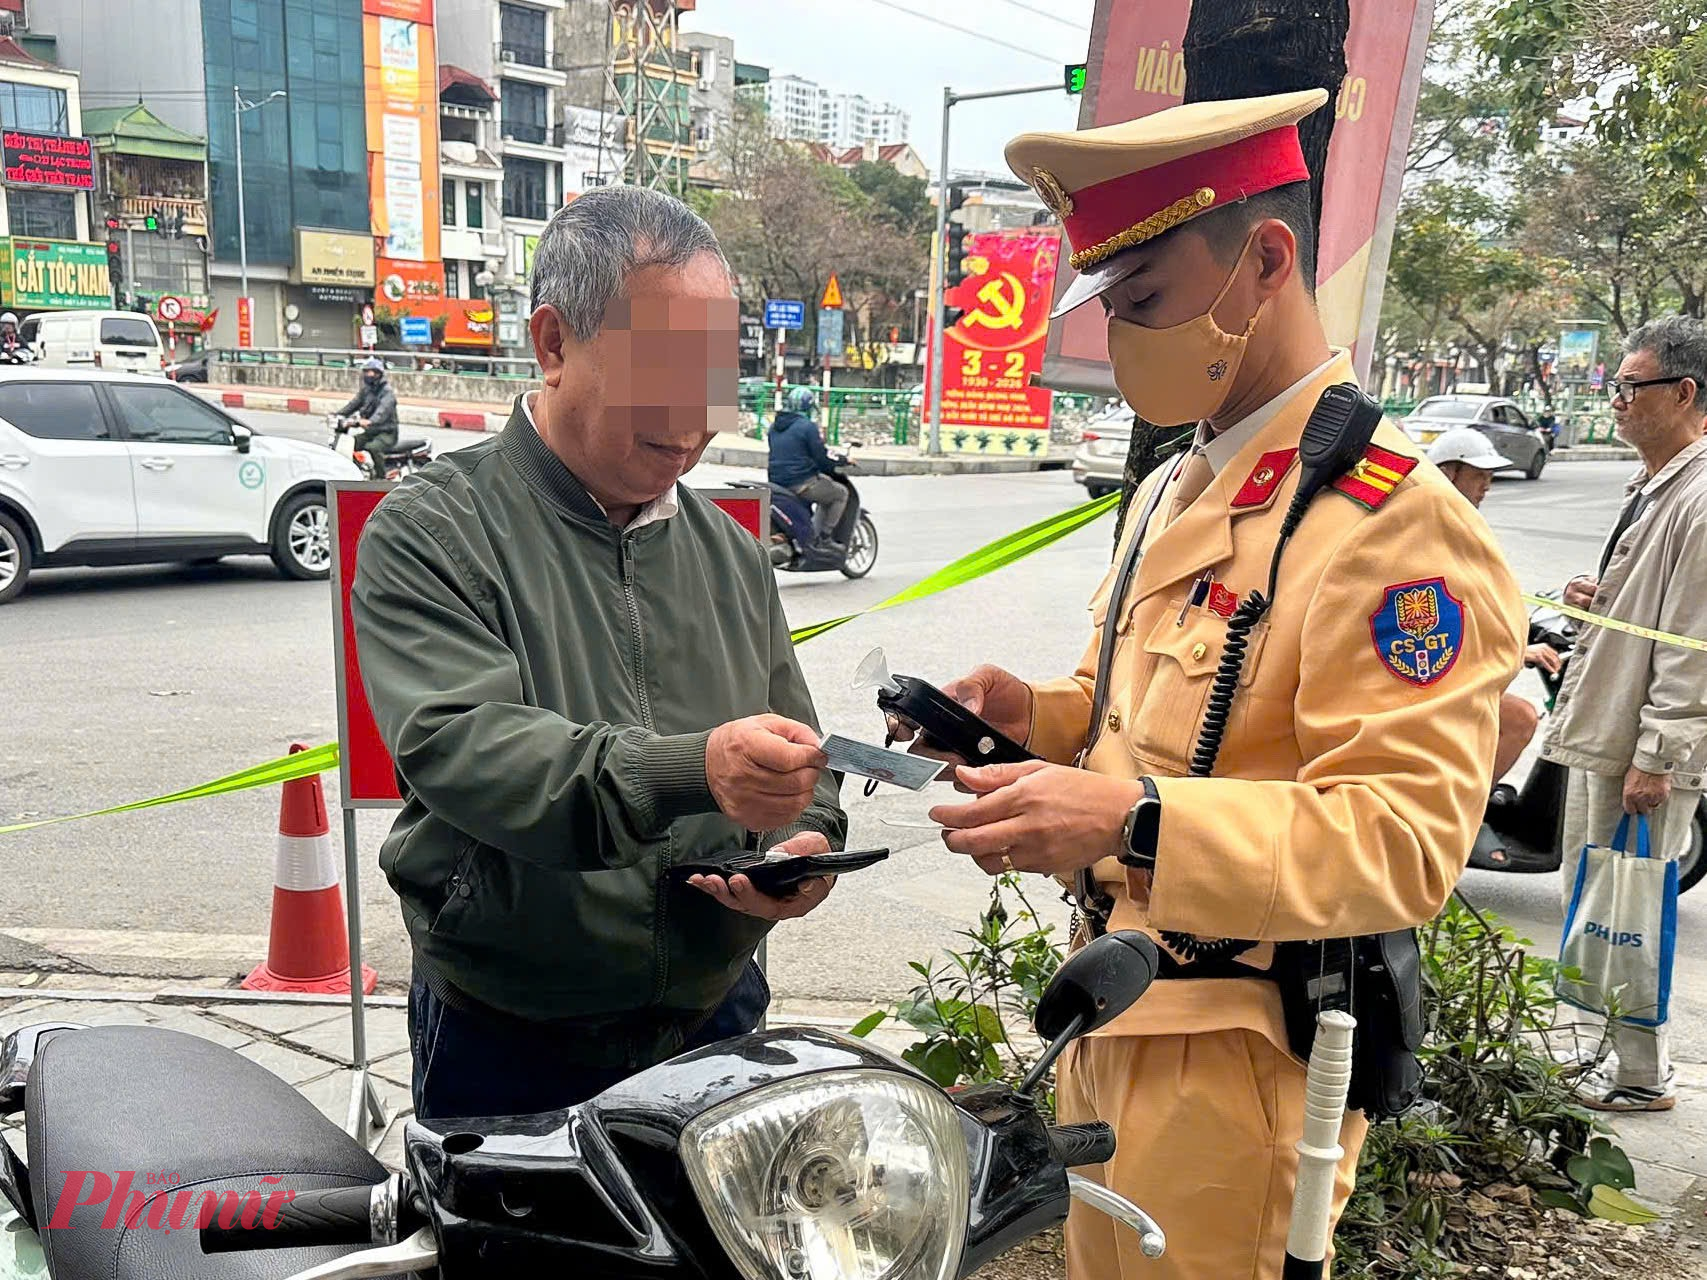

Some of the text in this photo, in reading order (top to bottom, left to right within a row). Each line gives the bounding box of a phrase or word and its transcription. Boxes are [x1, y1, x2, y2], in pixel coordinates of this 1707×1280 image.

[16, 249, 45, 293] CẮT
[47, 255, 76, 295] TÓC
[77, 263, 111, 296] NAM
[962, 350, 982, 376] 3
[1004, 351, 1024, 378] 2
